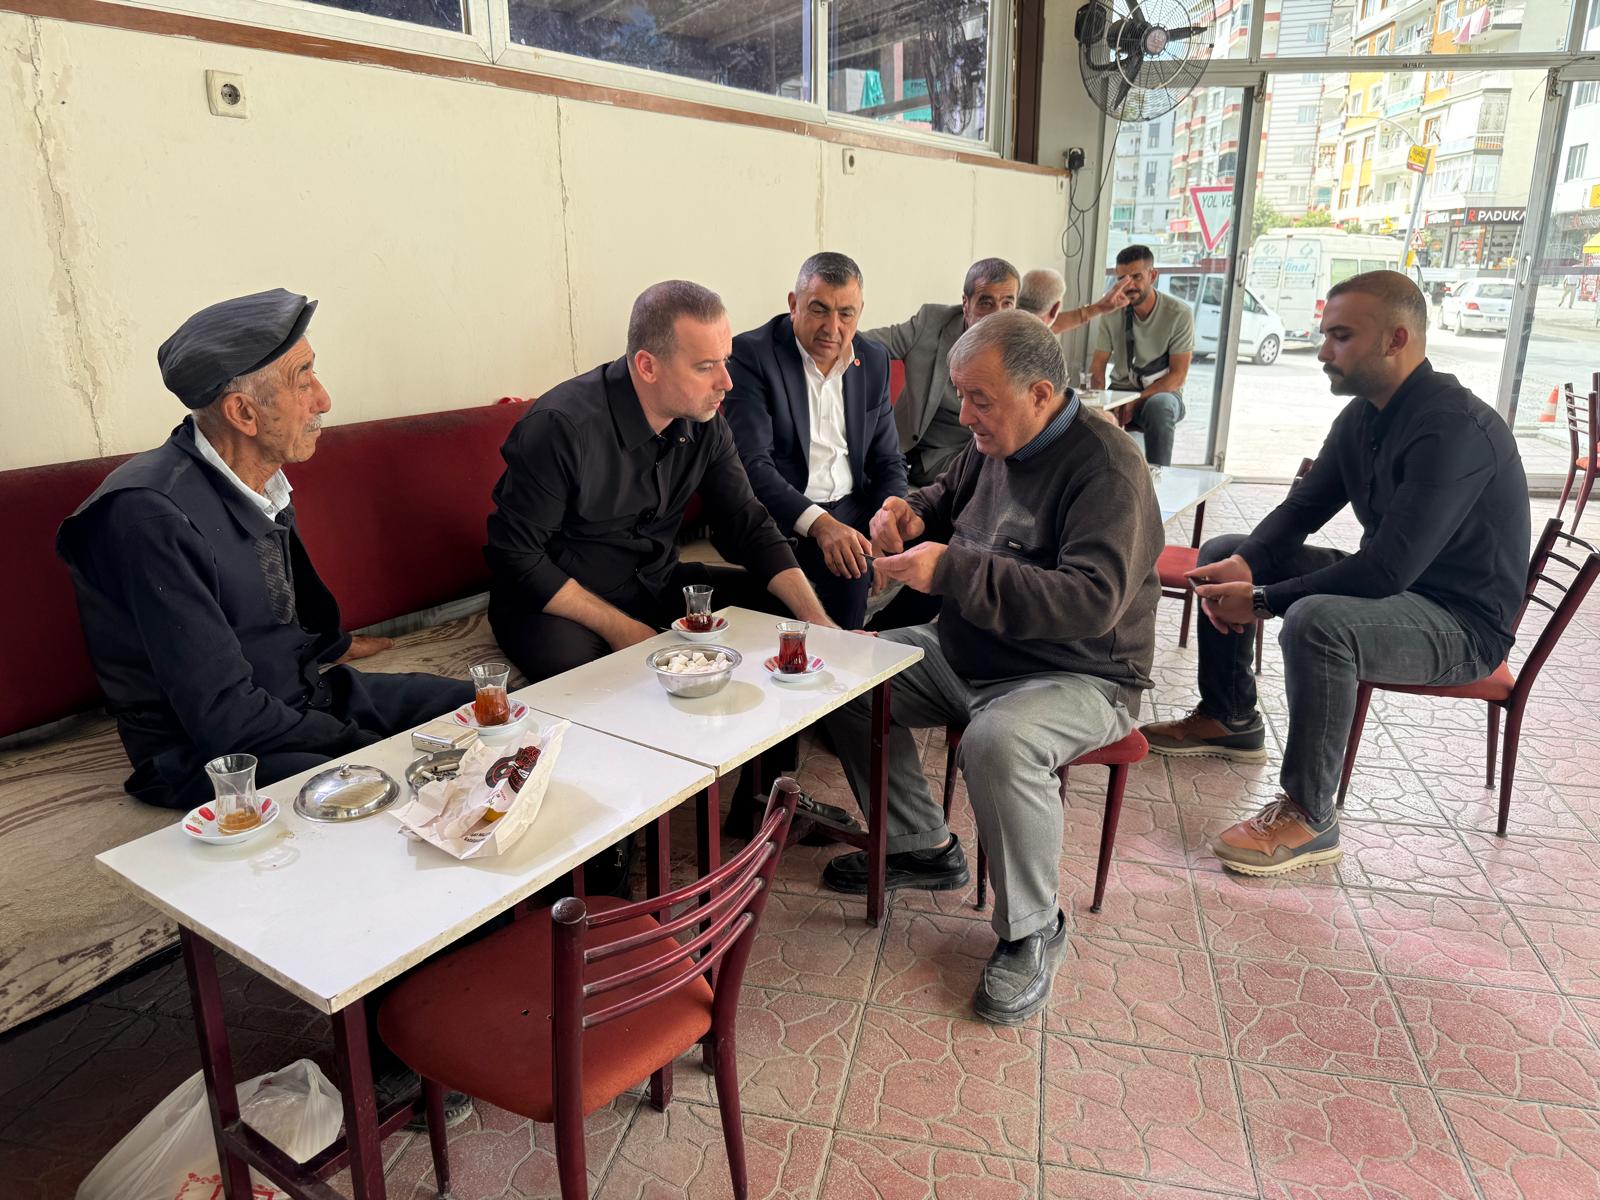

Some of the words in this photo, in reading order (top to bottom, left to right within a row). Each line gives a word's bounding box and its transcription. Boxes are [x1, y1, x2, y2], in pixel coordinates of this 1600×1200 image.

[1202, 195, 1217, 208] YOL
[1221, 194, 1232, 208] VE
[1478, 210, 1526, 221] PADUKA
